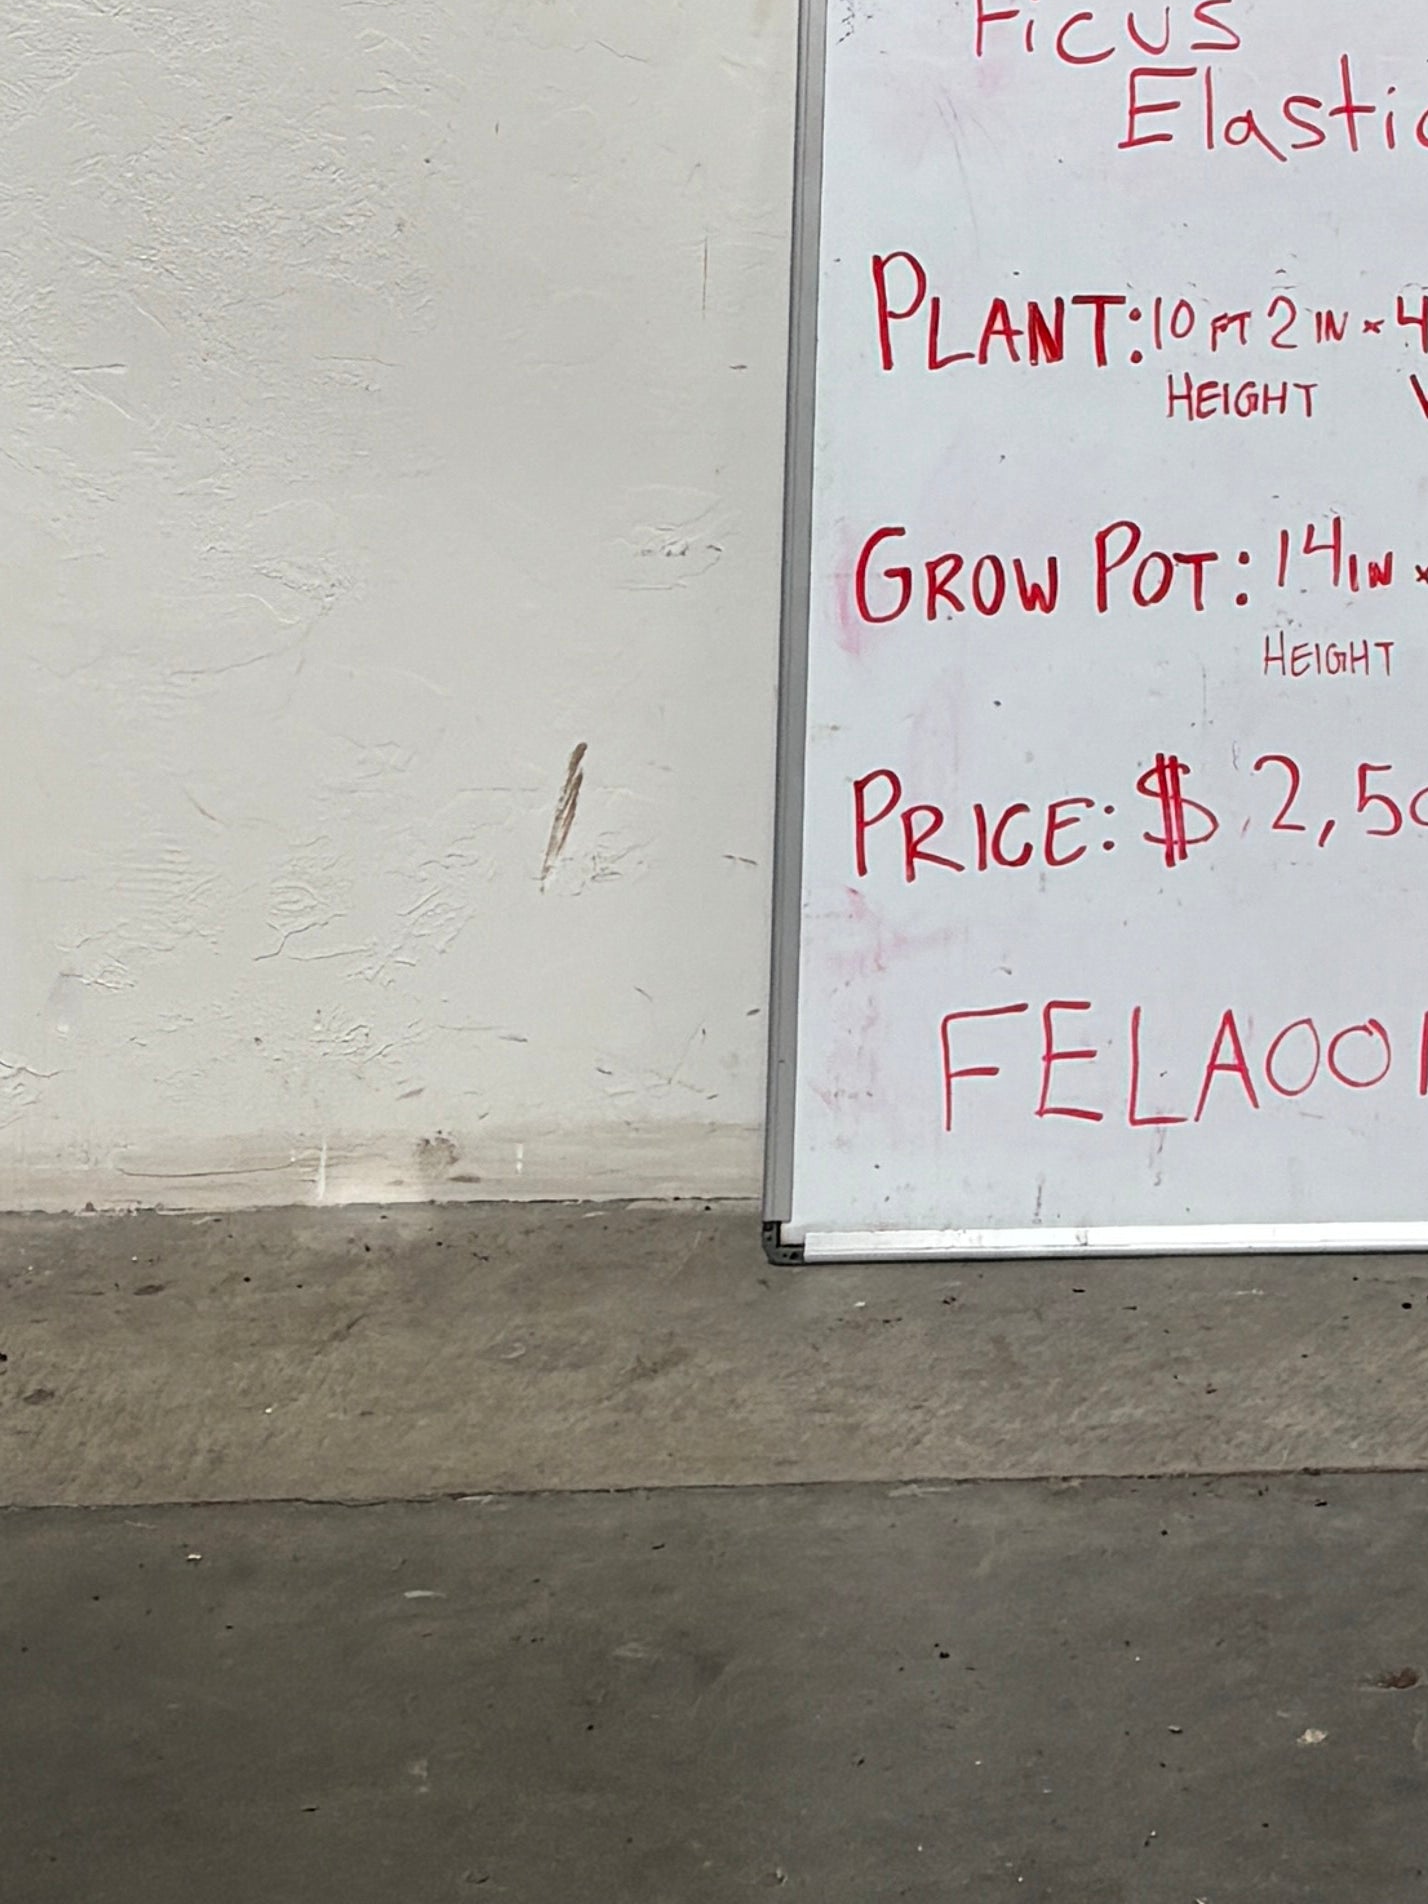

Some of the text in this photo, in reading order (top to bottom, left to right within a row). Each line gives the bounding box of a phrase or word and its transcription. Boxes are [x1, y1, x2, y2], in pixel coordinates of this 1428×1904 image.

[1152, 296, 1197, 350] 10
[1267, 294, 1299, 351] 2
[1313, 309, 1349, 344] IN
[1166, 372, 1319, 421] HEIGHT
[852, 524, 1059, 625] GROW
[1093, 518, 1251, 614] POT:
[1263, 628, 1396, 678] HEIGHT
[851, 767, 1116, 883] PRICE:
